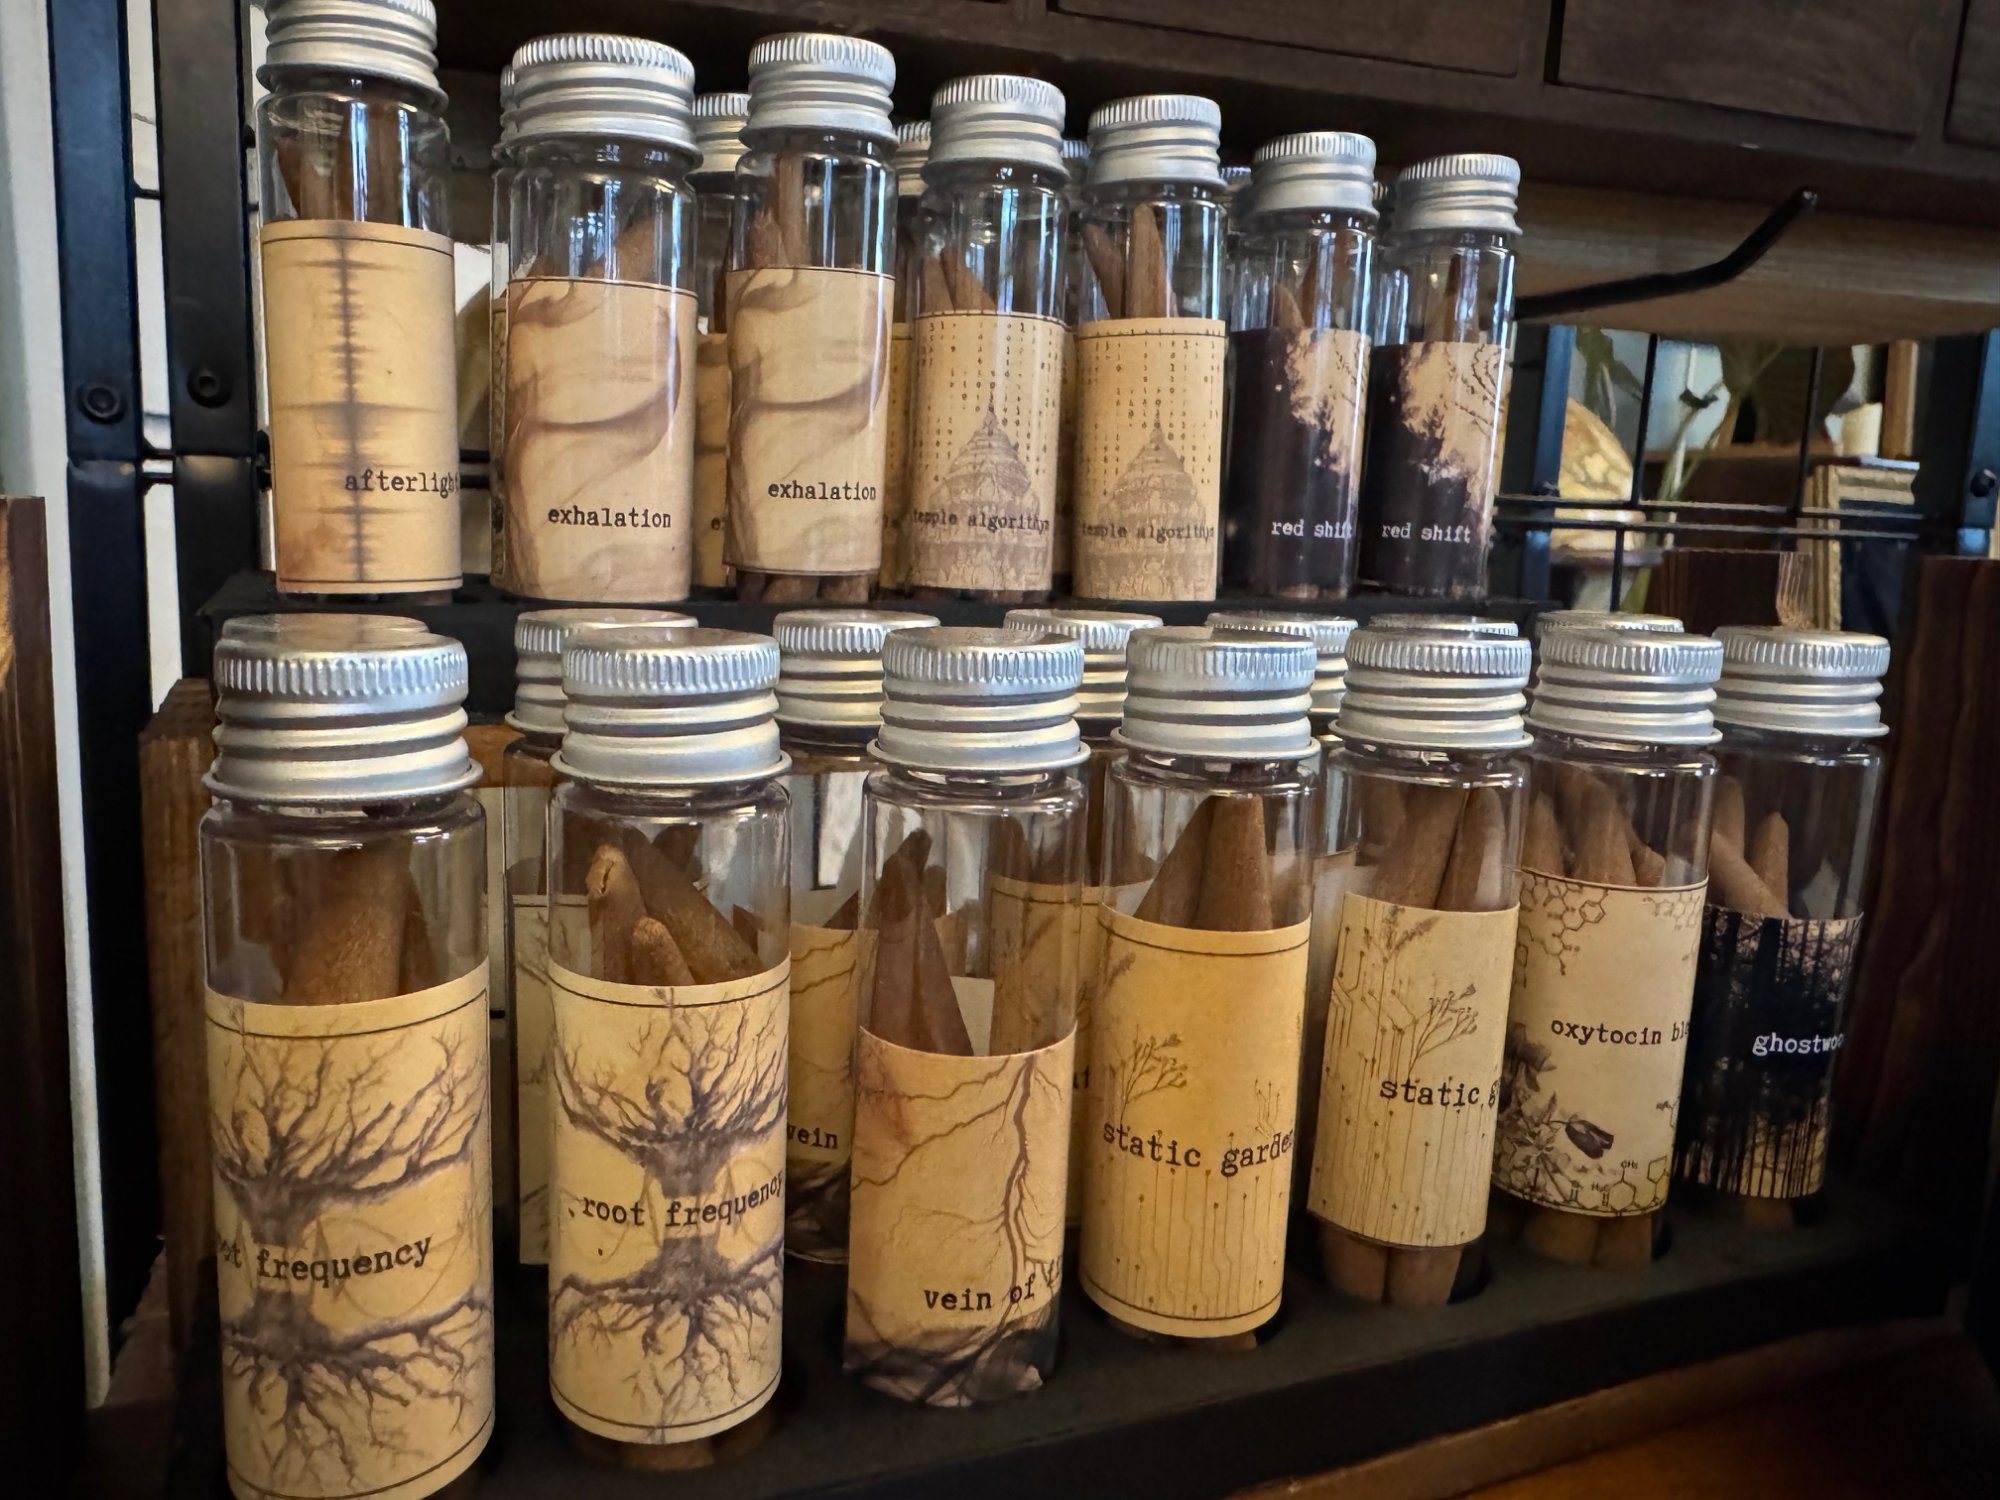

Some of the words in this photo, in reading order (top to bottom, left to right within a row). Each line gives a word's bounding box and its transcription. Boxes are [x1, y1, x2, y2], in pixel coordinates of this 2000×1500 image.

[768, 480, 876, 501] exhalation
[548, 505, 671, 528] exhalation
[1271, 519, 1304, 537] red
[1382, 522, 1410, 539] red
[1420, 524, 1471, 543] shift
[1551, 1020, 1661, 1046] oxytocin
[1380, 1078, 1480, 1107] static
[786, 1123, 838, 1150] vein
[1103, 1122, 1201, 1168] static
[1220, 1129, 1294, 1178] garde
[583, 1196, 645, 1226] root
[666, 1171, 784, 1228] frequency
[257, 1233, 433, 1288] frequency
[924, 1287, 992, 1311] vein
[1010, 1272, 1036, 1304] of
